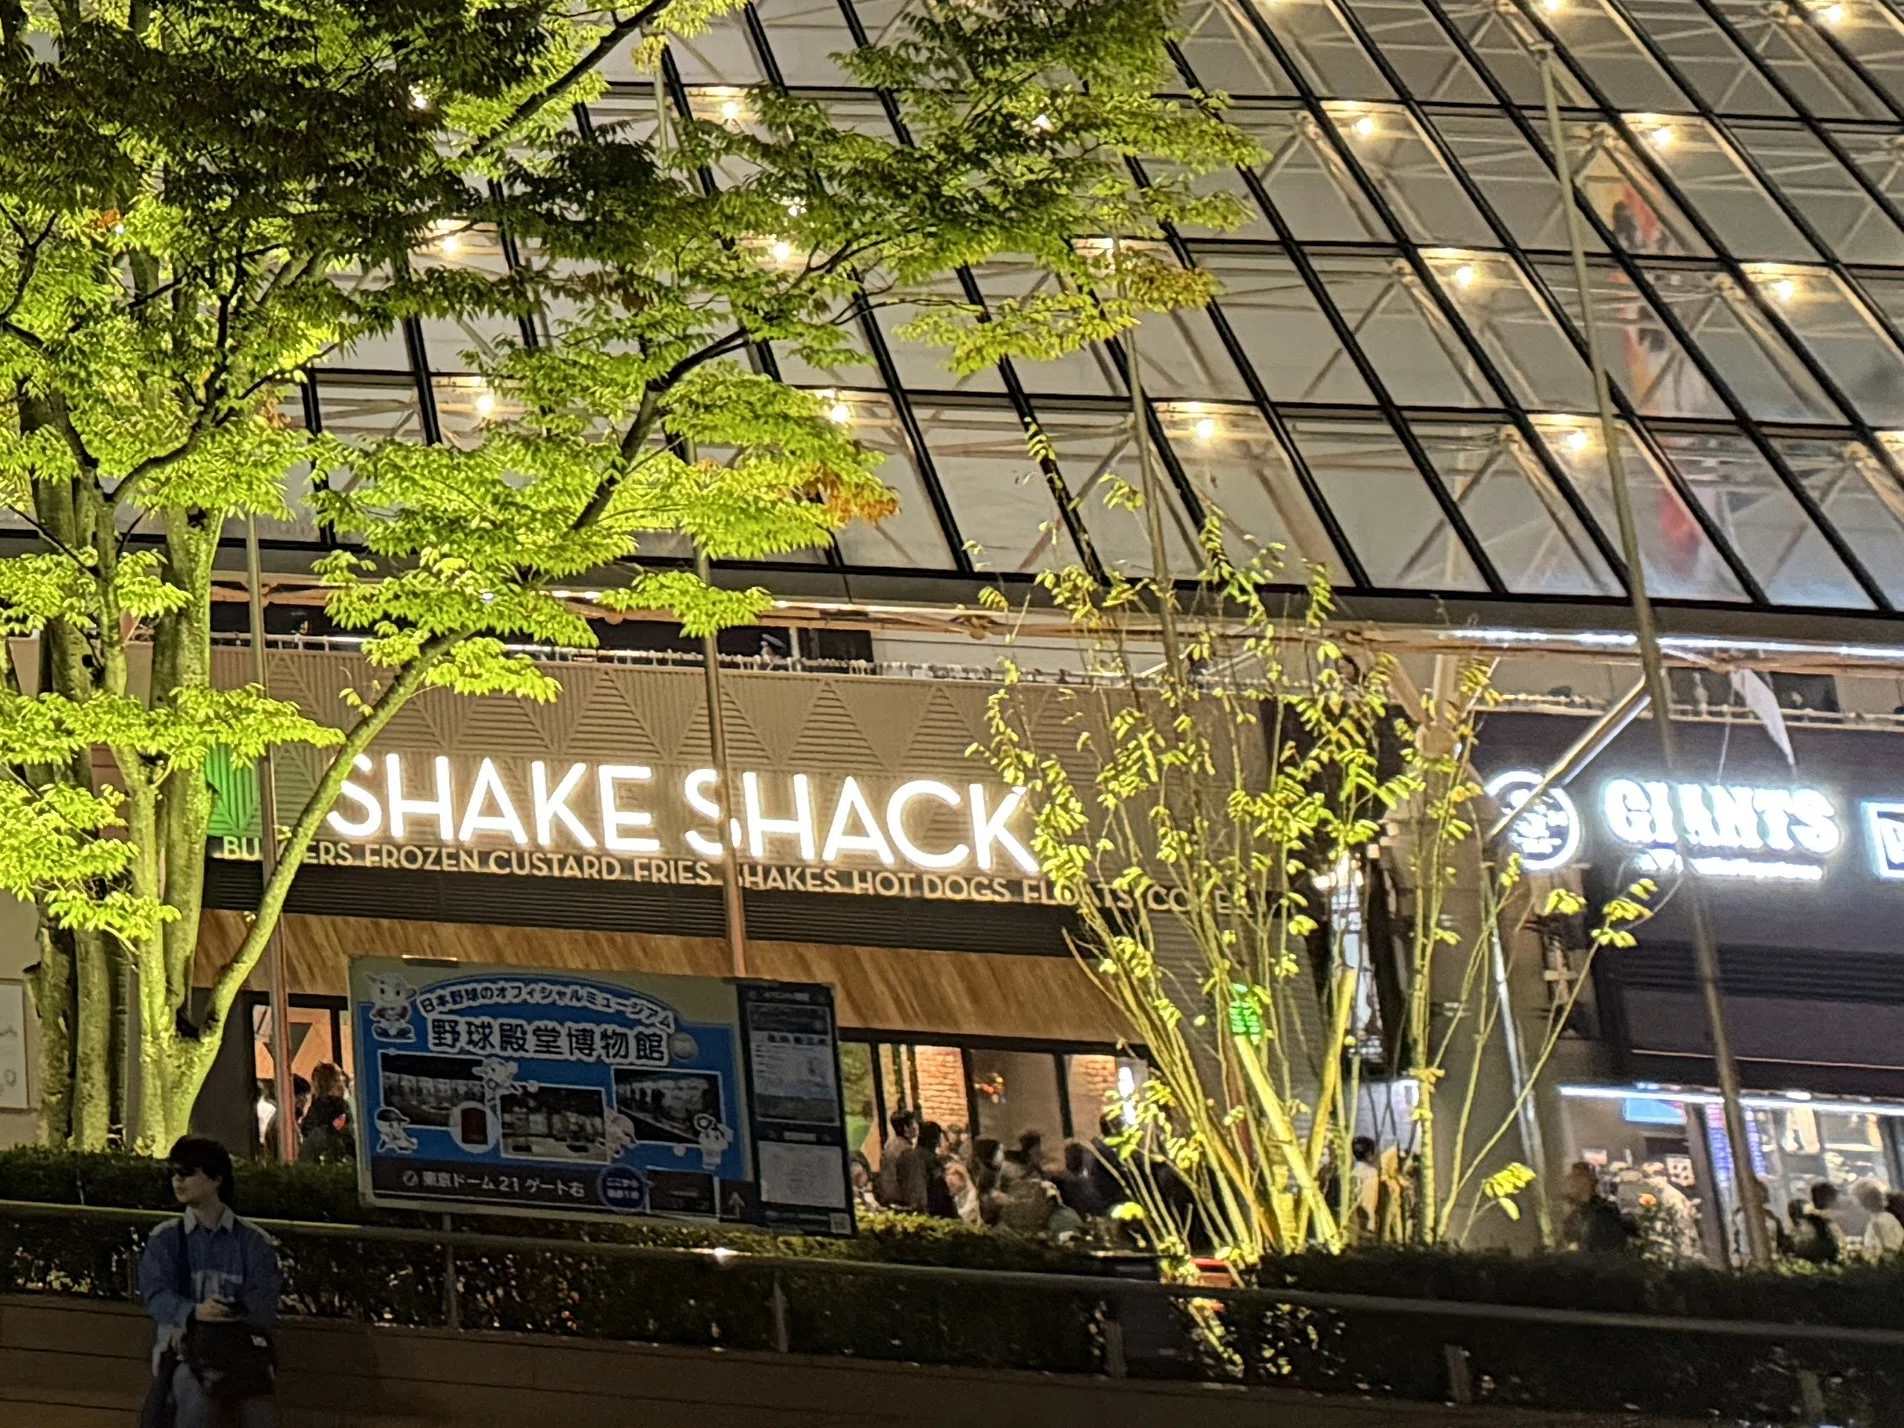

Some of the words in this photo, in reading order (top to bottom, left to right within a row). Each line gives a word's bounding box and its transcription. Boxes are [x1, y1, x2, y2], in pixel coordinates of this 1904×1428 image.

[326, 752, 661, 851] SHAKE
[683, 768, 1041, 872] SHACK
[1604, 778, 1842, 854] GIANTS
[223, 835, 353, 866] BUERS
[366, 845, 481, 873] FROZEN
[488, 850, 621, 881] CUSTARD
[635, 858, 713, 886] FRIES
[737, 864, 841, 893] HAKES
[853, 870, 916, 897] HOT
[923, 874, 1011, 902] DOGS
[419, 983, 674, 1031] 日本野球のオフィシャルミュージアム
[430, 1017, 667, 1063] 野球殿堂博物館
